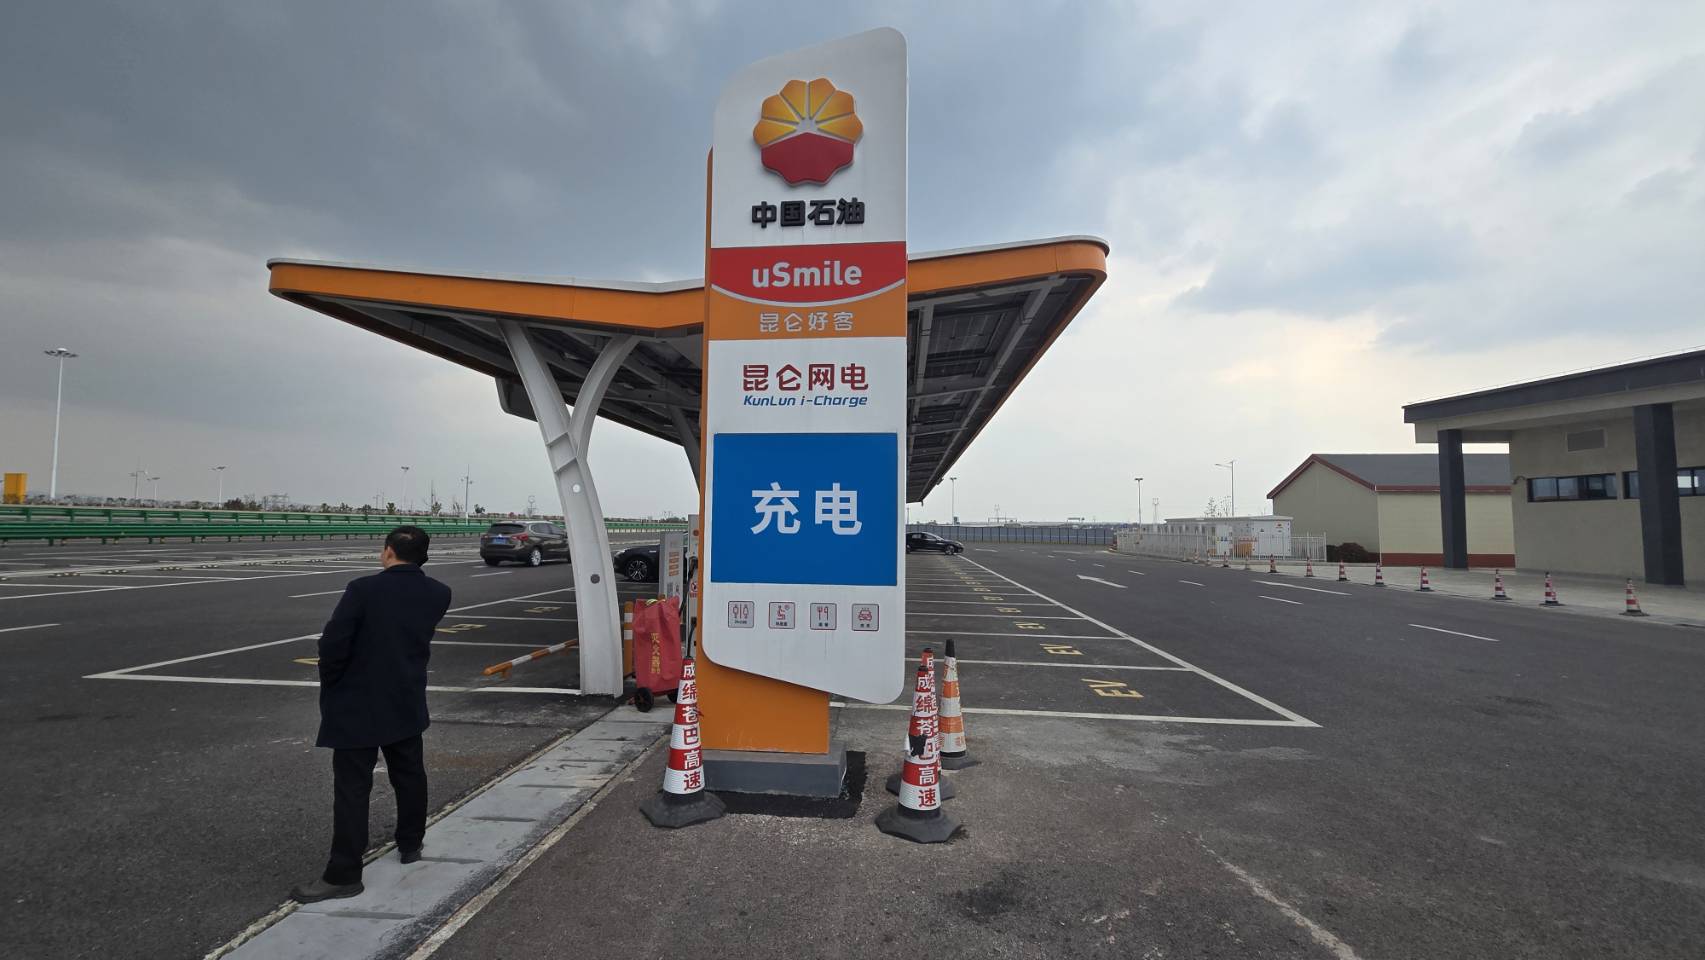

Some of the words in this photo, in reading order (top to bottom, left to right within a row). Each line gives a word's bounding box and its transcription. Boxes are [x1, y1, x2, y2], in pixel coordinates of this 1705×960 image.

[751, 197, 865, 229] 中国石油
[751, 260, 862, 288] uSmile
[759, 311, 854, 333] 昆仑好客
[743, 363, 869, 392] 昆仑网电
[743, 395, 796, 406] KunLun
[800, 395, 868, 408] i-Charge
[750, 482, 863, 535] 充电
[1040, 643, 1084, 656] EV
[1081, 678, 1145, 698] EV
[682, 662, 701, 791] 成绵苍巴高速
